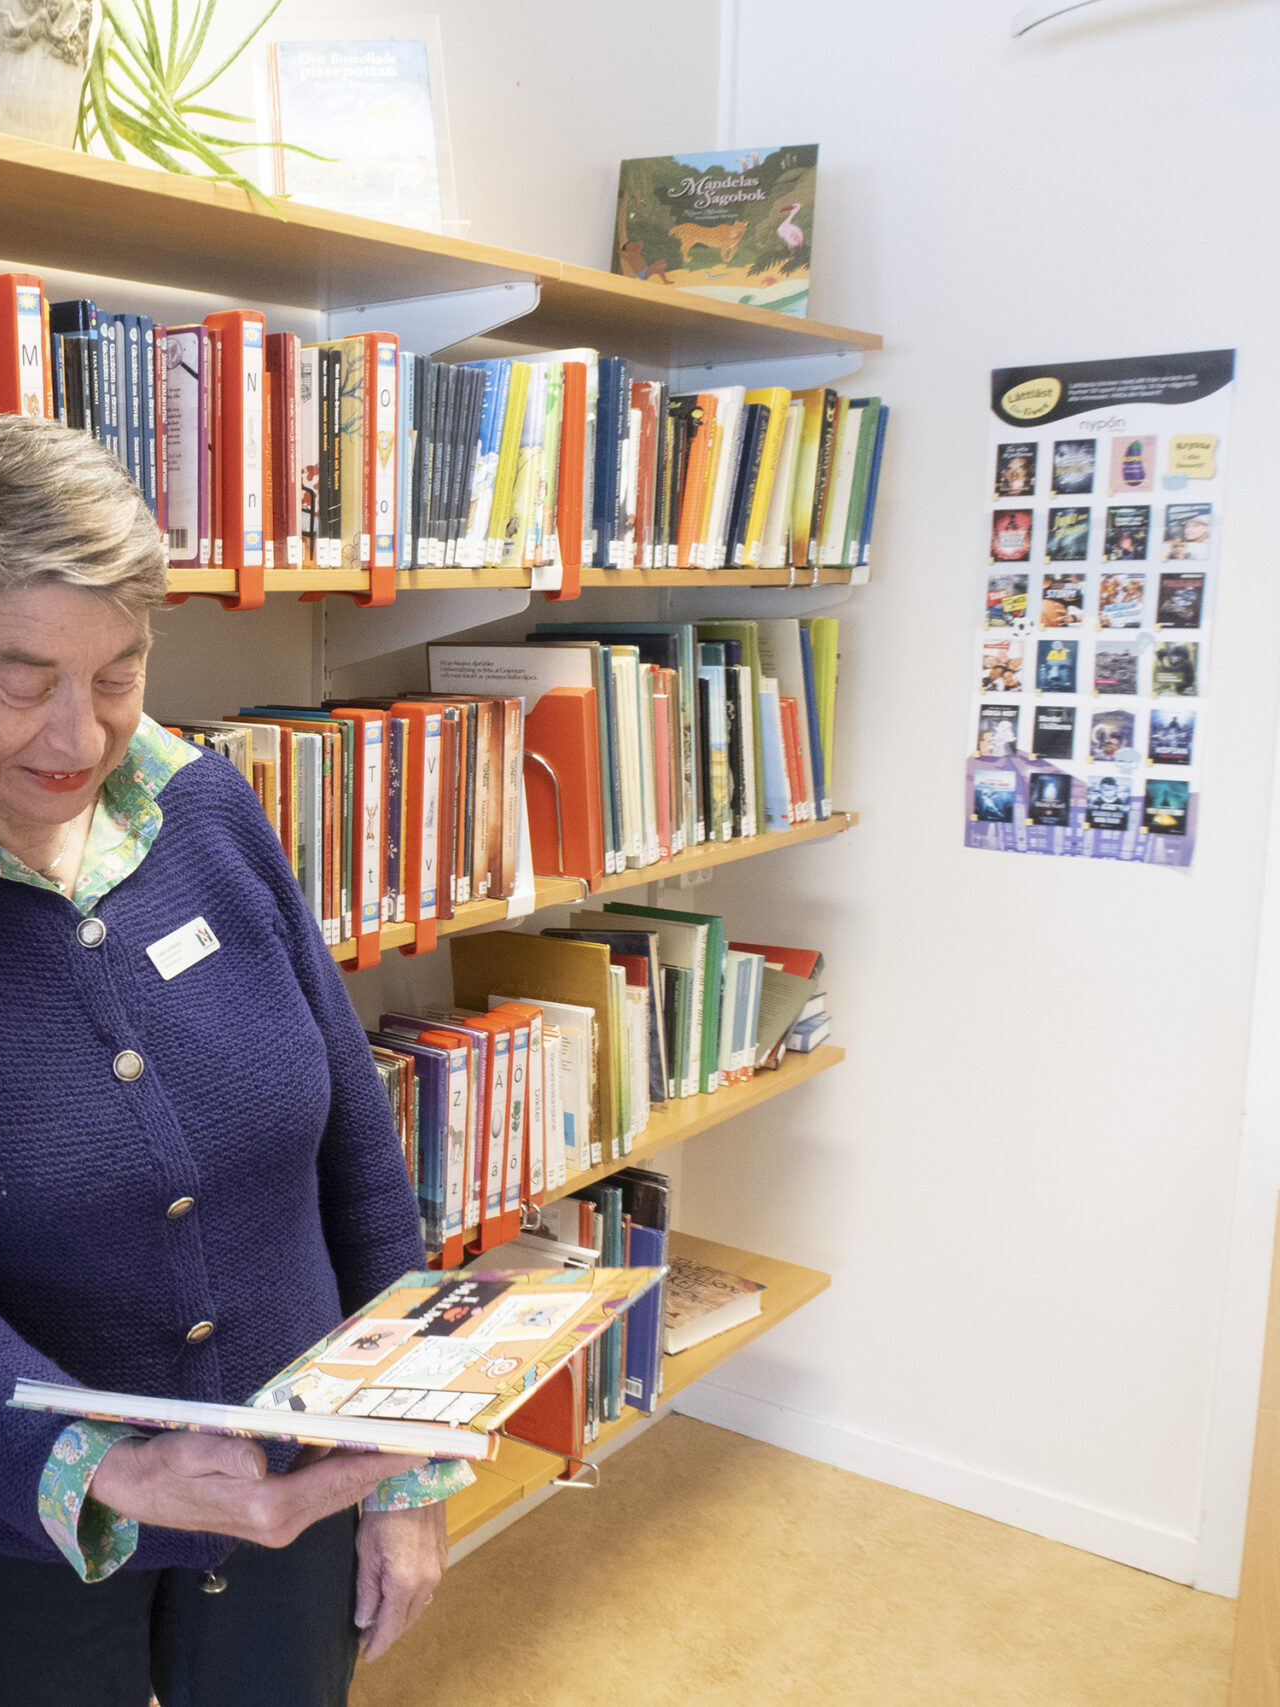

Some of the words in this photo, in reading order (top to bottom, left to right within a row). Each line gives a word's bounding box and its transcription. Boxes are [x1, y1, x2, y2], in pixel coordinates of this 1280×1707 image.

[668, 175, 759, 198] Mandelas
[693, 188, 766, 209] Sagobok
[22, 343, 39, 367] M
[247, 373, 257, 392] N
[381, 389, 391, 408] O
[1006, 388, 1054, 404] Lättläst
[248, 491, 257, 508] n
[380, 499, 389, 514] o
[368, 765, 377, 783] T
[426, 756, 436, 775] V
[425, 857, 433, 871] v
[368, 867, 374, 884] t
[513, 1063, 522, 1083] Ö
[453, 1090, 461, 1107] Z
[510, 1153, 517, 1169] ö
[451, 1183, 457, 1195] z
